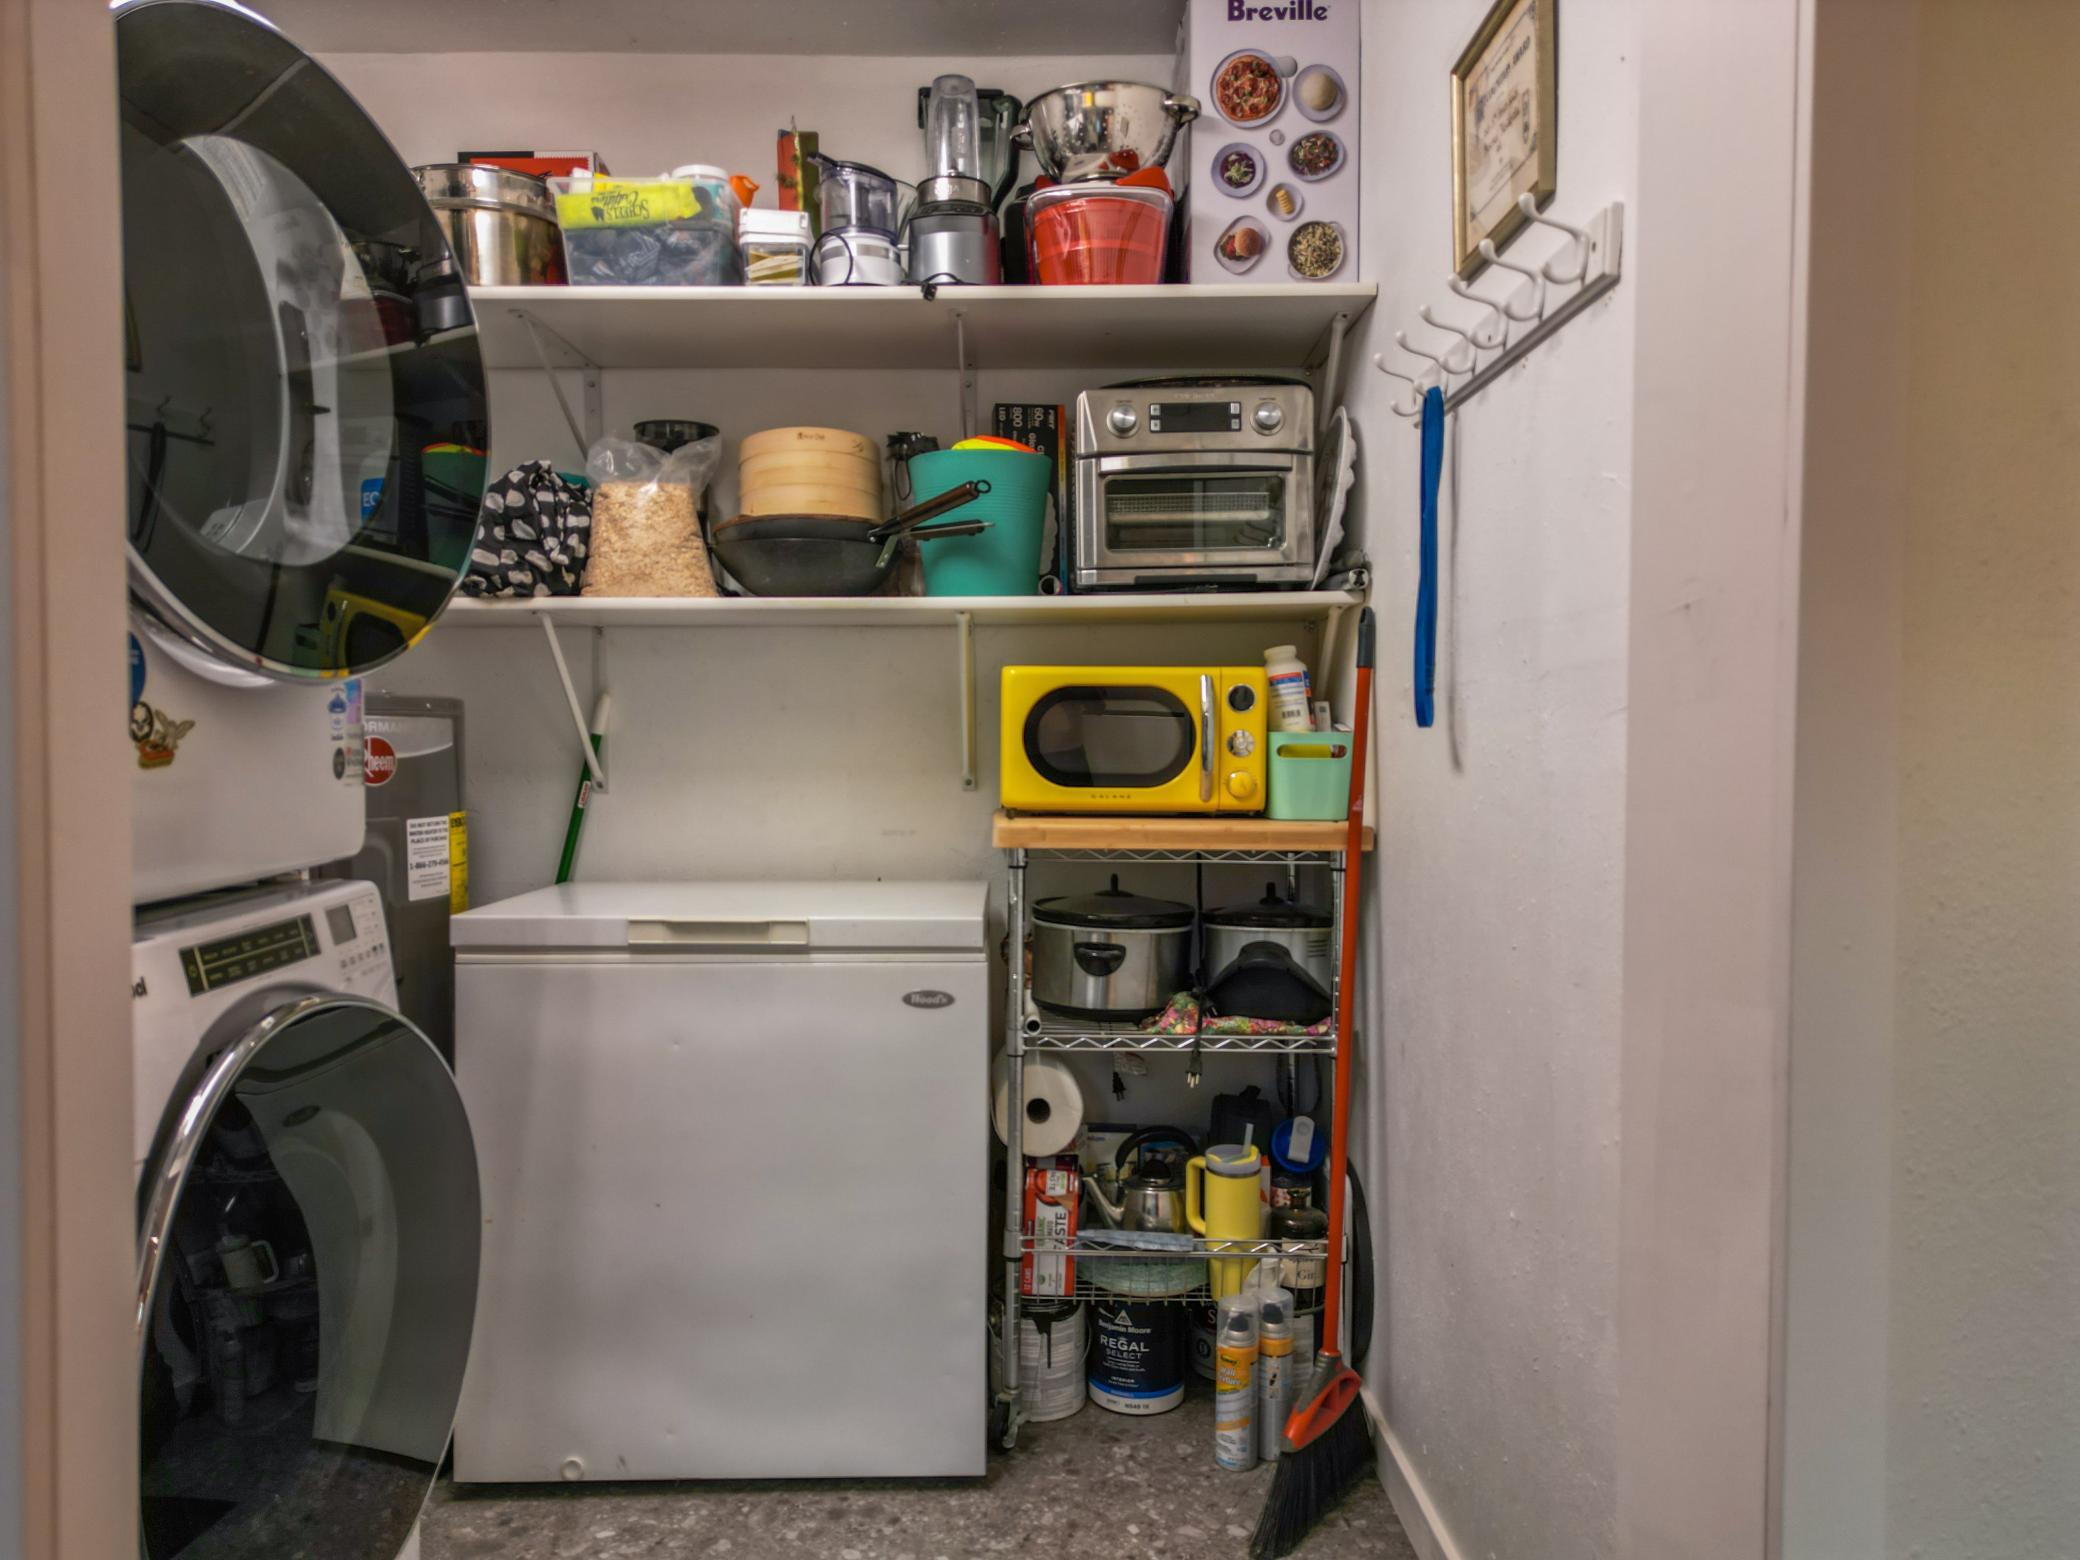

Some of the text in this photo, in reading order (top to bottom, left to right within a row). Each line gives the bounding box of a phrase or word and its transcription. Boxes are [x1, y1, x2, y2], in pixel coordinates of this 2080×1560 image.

[1227, 0, 1328, 21] Breville
[998, 407, 1006, 421] LED
[1012, 407, 1023, 428] 800
[1098, 1319, 1151, 1334] Benjamin Moore
[1100, 1334, 1150, 1352] REGAL
[1105, 1348, 1142, 1359] SELECT
